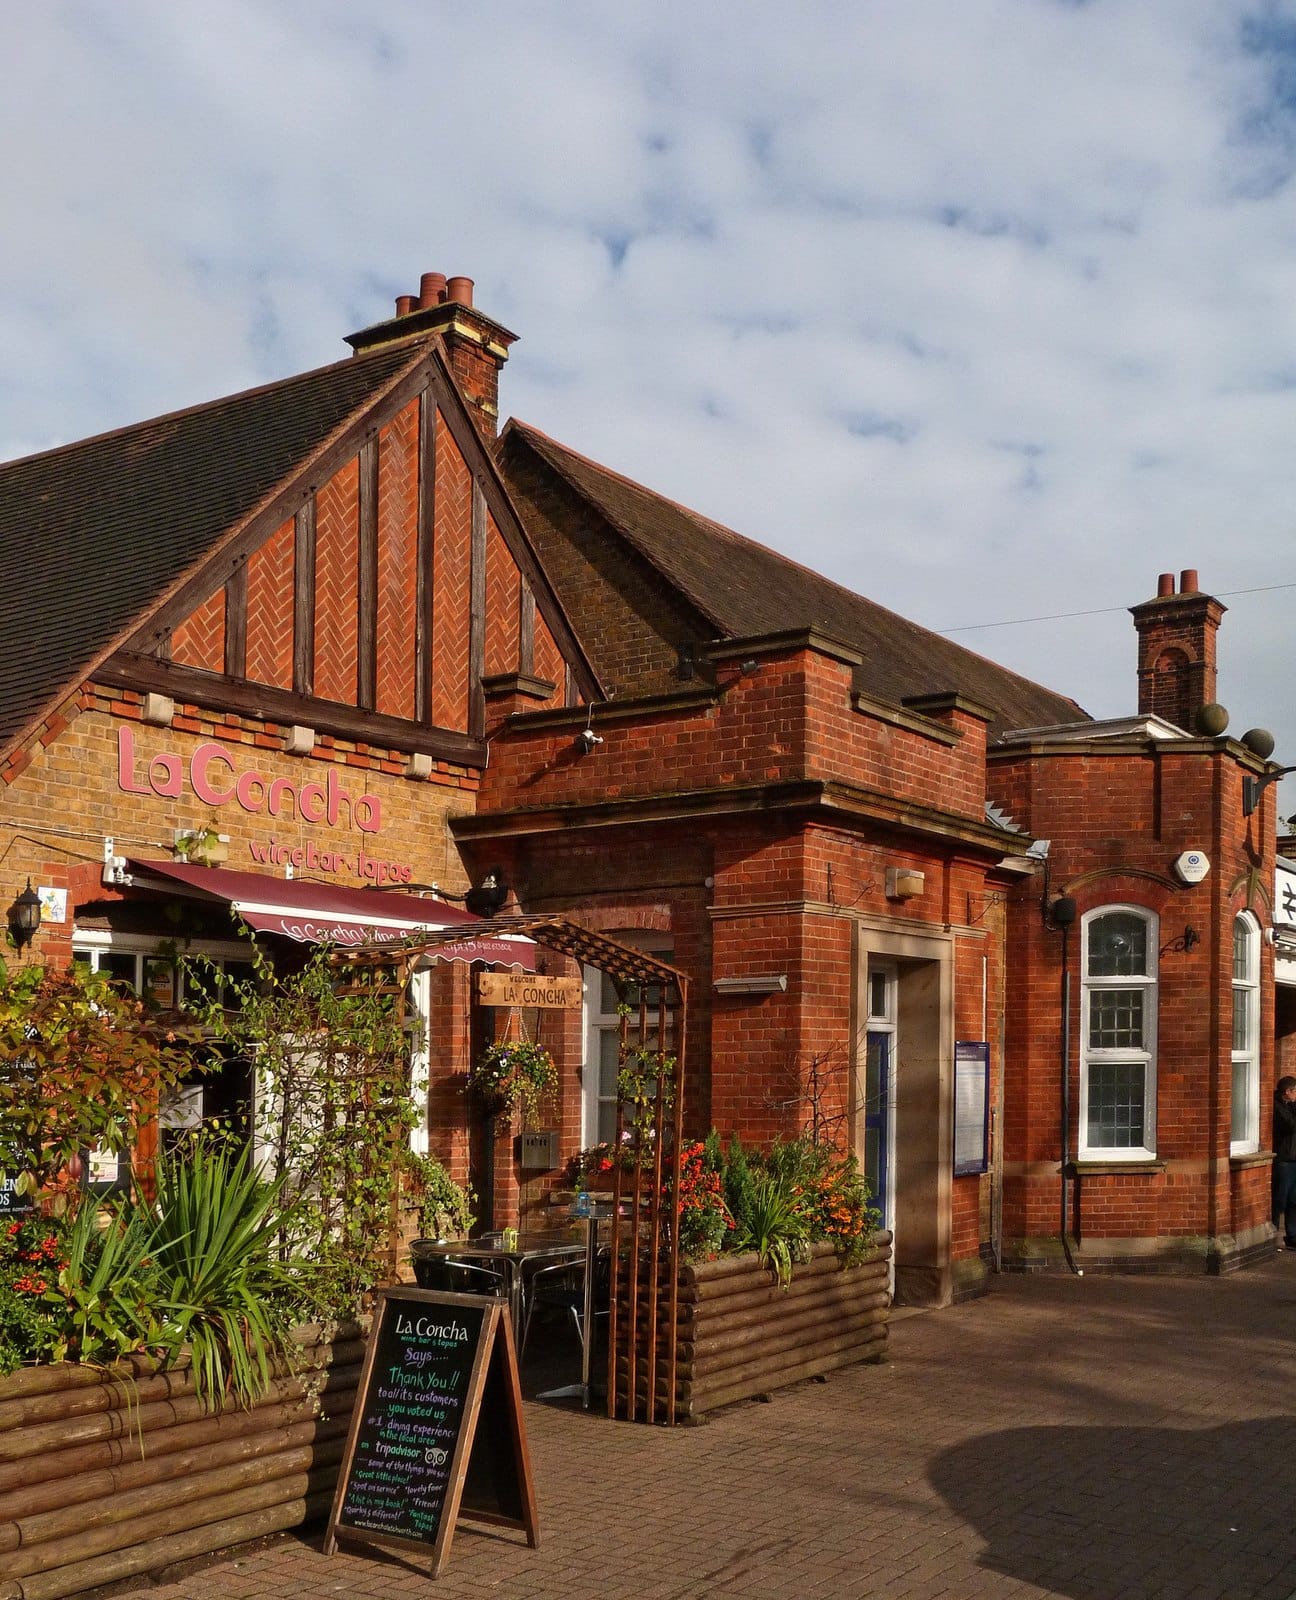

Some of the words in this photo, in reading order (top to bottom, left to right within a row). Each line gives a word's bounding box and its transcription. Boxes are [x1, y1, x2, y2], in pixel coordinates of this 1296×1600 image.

[118, 725, 183, 799] La
[190, 743, 382, 833] Concha
[250, 838, 303, 867] wine
[305, 840, 347, 873] bar
[357, 850, 413, 887] tapas
[509, 975, 537, 984] WELCOME
[503, 986, 516, 1002] LA
[523, 988, 567, 1005] CONCHA
[395, 1314, 412, 1334] La
[416, 1317, 468, 1341] Concha
[401, 1335, 417, 1343] wine
[419, 1336, 431, 1345] bar
[437, 1339, 458, 1349] tapas
[389, 1366, 424, 1390] Thank
[414, 1390, 458, 1407] customers
[407, 1406, 433, 1418] voted
[386, 1429, 399, 1440] the
[399, 1432, 417, 1444] local
[418, 1436, 436, 1446] area
[375, 1440, 421, 1458] tripadvisor
[385, 1460, 393, 1470] of
